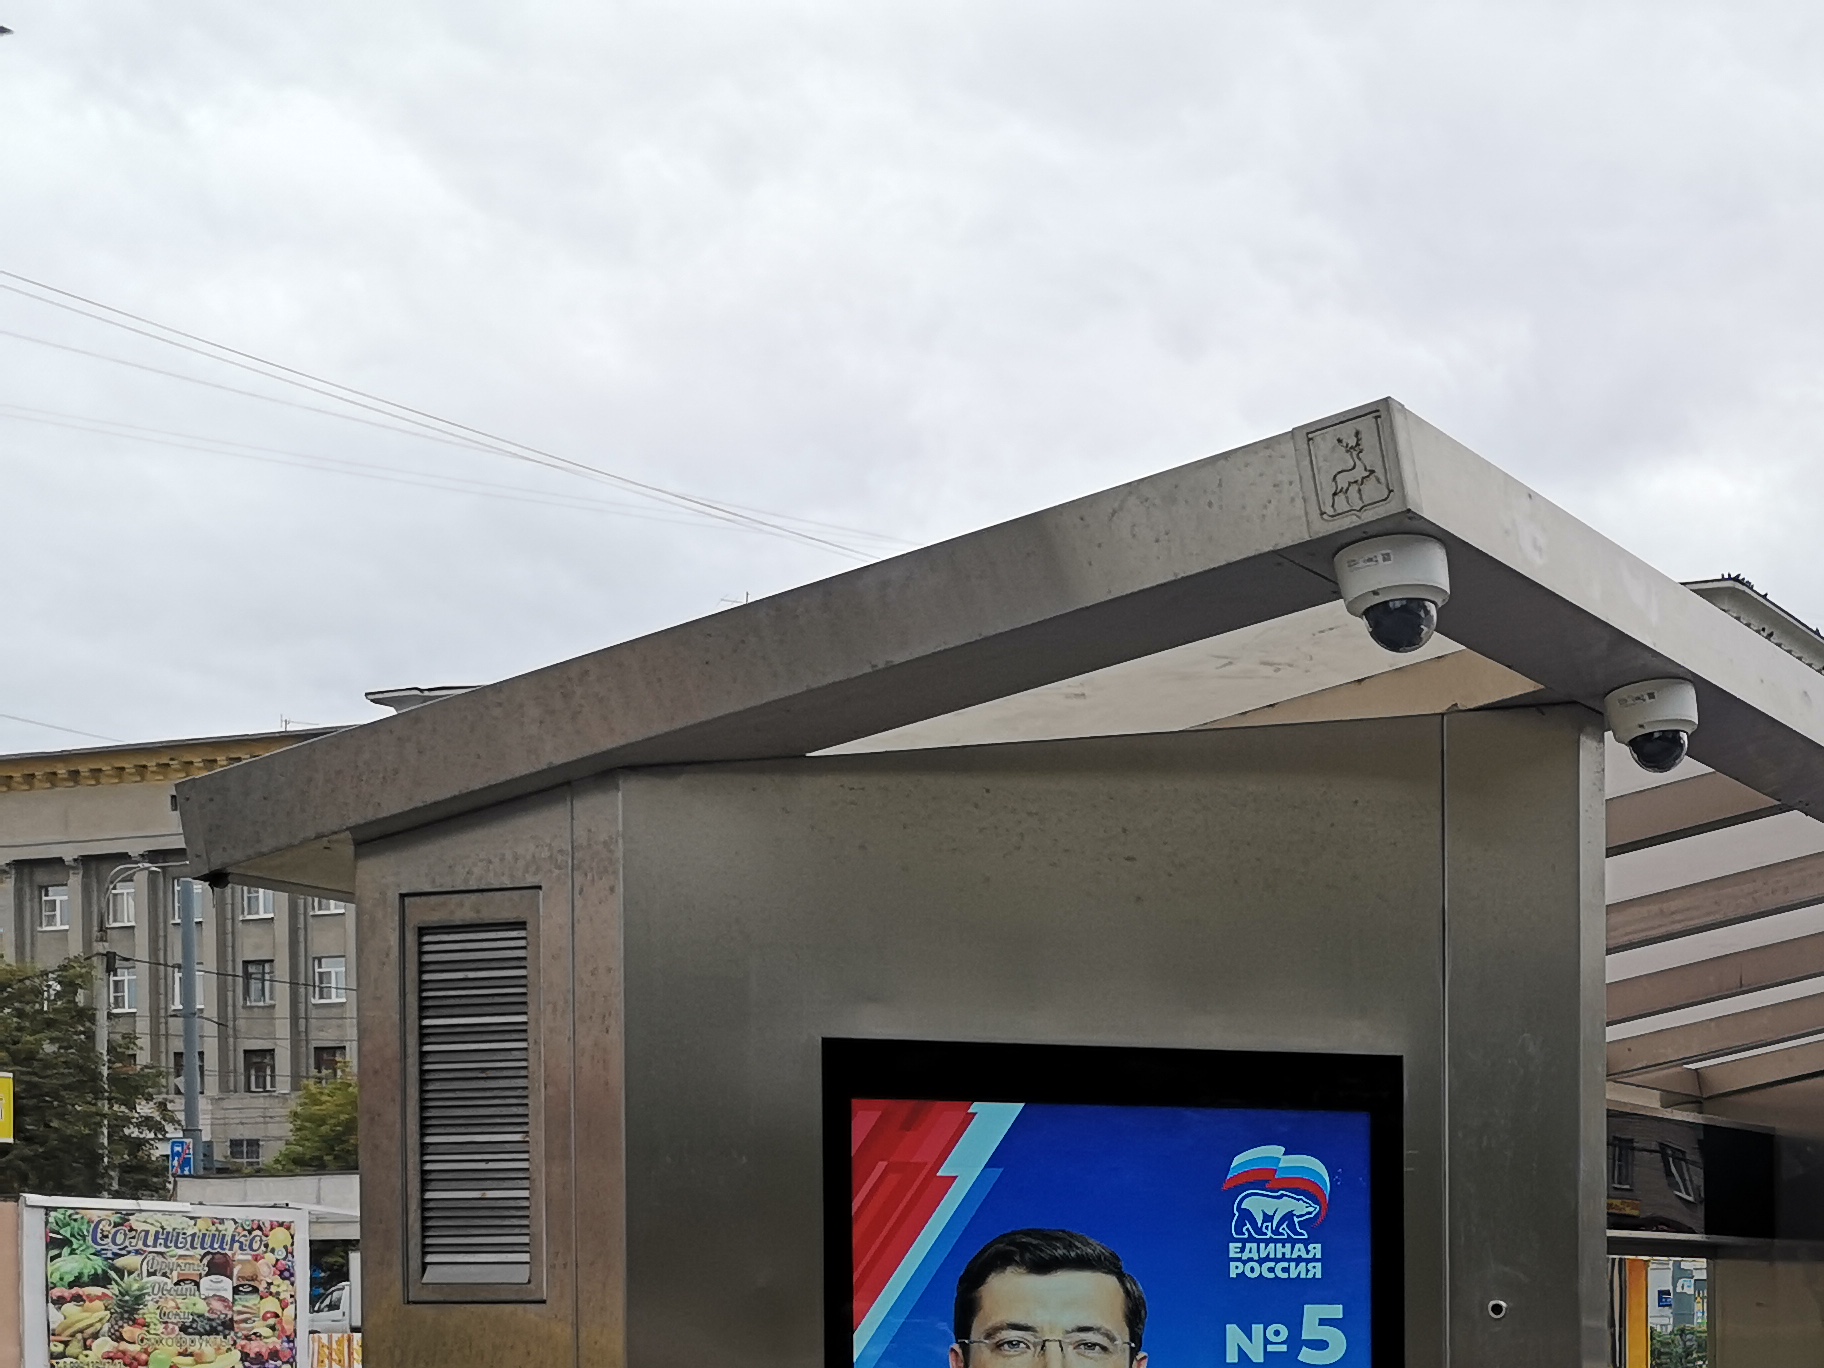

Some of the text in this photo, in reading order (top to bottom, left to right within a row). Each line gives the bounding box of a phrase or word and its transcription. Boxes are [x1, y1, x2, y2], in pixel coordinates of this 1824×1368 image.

[91, 1218, 266, 1251] Солнышко
[1228, 1242, 1322, 1261] ЕДИНАЯ
[148, 1254, 208, 1276] Фрукты
[1229, 1261, 1322, 1279] РОССИЯ
[151, 1280, 198, 1300] Овощи
[157, 1304, 191, 1322] Соки
[137, 1332, 233, 1352] Сухофрукты
